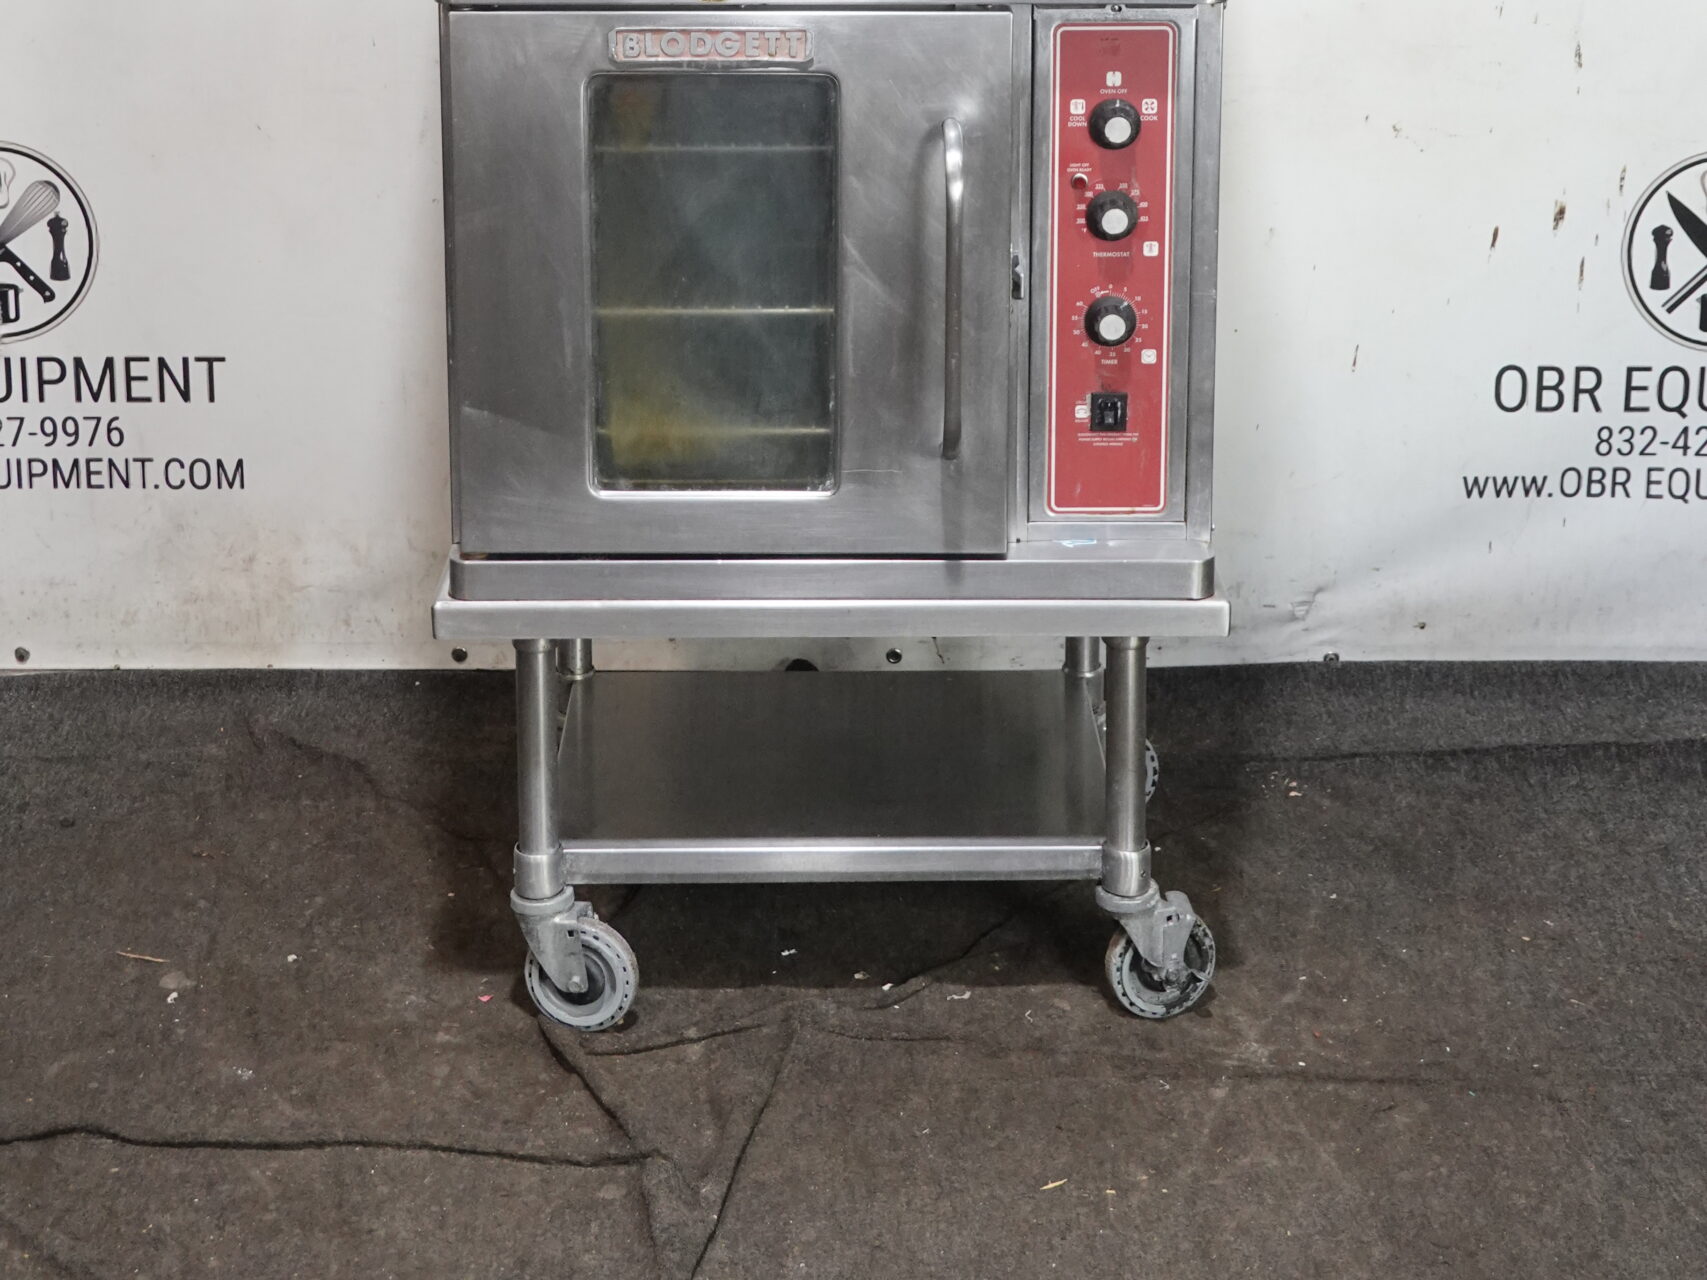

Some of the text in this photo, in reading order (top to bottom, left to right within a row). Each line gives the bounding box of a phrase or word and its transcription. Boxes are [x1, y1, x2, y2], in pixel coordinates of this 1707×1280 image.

[622, 30, 801, 58] BLODGETT
[1494, 364, 1602, 413] OBR
[0, 416, 125, 447] 7-9976
[1595, 425, 1707, 457] 832-42
[1463, 466, 1631, 499] www.OBR
